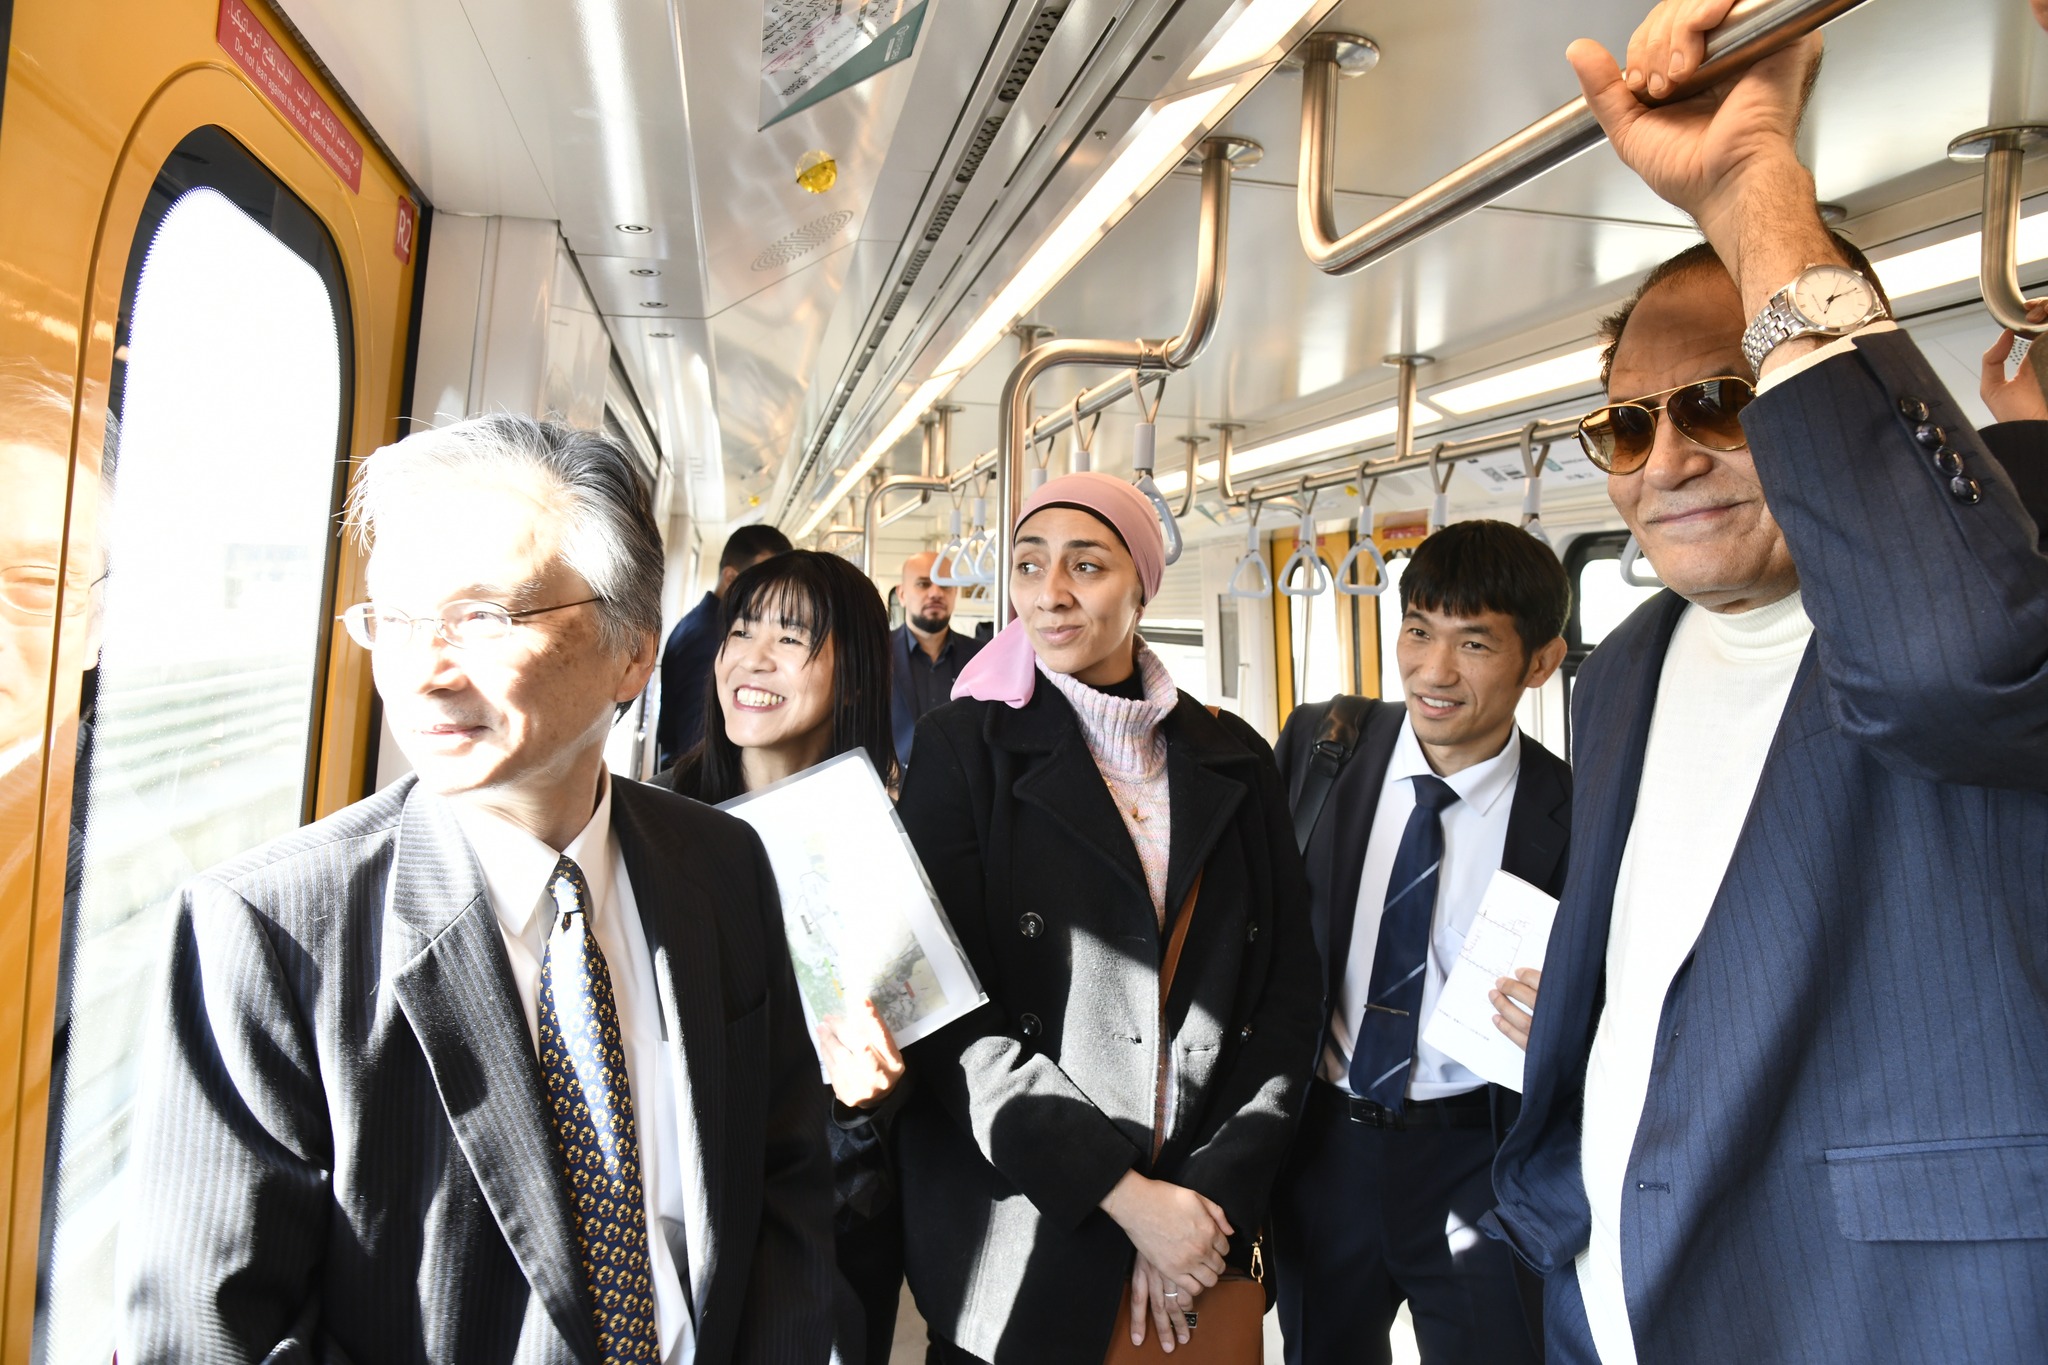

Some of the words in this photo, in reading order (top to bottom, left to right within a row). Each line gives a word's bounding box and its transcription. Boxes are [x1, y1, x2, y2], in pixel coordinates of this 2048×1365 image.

[262, 46, 276, 71] يفتح
[277, 62, 292, 86] الباب
[234, 36, 244, 56] Do
[244, 51, 255, 70] not
[255, 61, 268, 84] lean
[268, 78, 287, 107] against
[287, 96, 295, 115] the
[295, 108, 308, 129] door.
[308, 121, 313, 135] It
[312, 130, 326, 150] opens
[310, 101, 321, 119] على
[337, 135, 346, 149] عدم
[397, 208, 412, 254] R2
